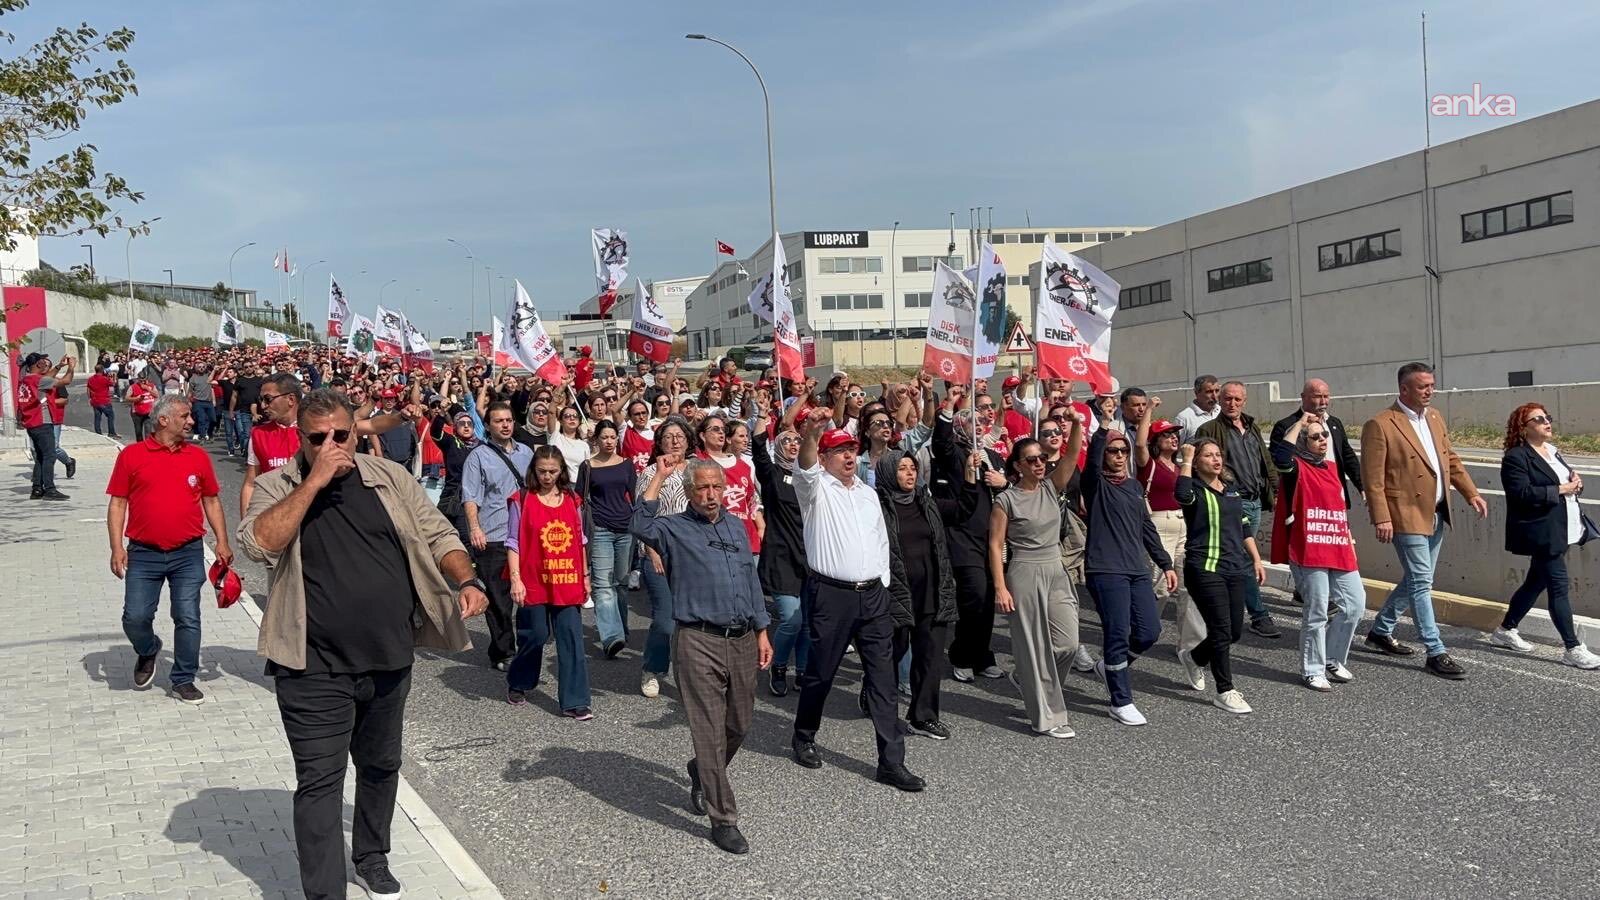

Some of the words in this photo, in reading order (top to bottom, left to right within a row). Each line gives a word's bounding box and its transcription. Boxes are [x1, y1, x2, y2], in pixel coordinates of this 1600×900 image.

[814, 233, 860, 246] LUBPART
[941, 320, 961, 335] DİSK
[976, 353, 998, 366] BİRLEŞİ
[1306, 507, 1348, 523] BİRLEŞİ
[1306, 534, 1349, 546] SENDİKA
[543, 558, 575, 571] EMEK
